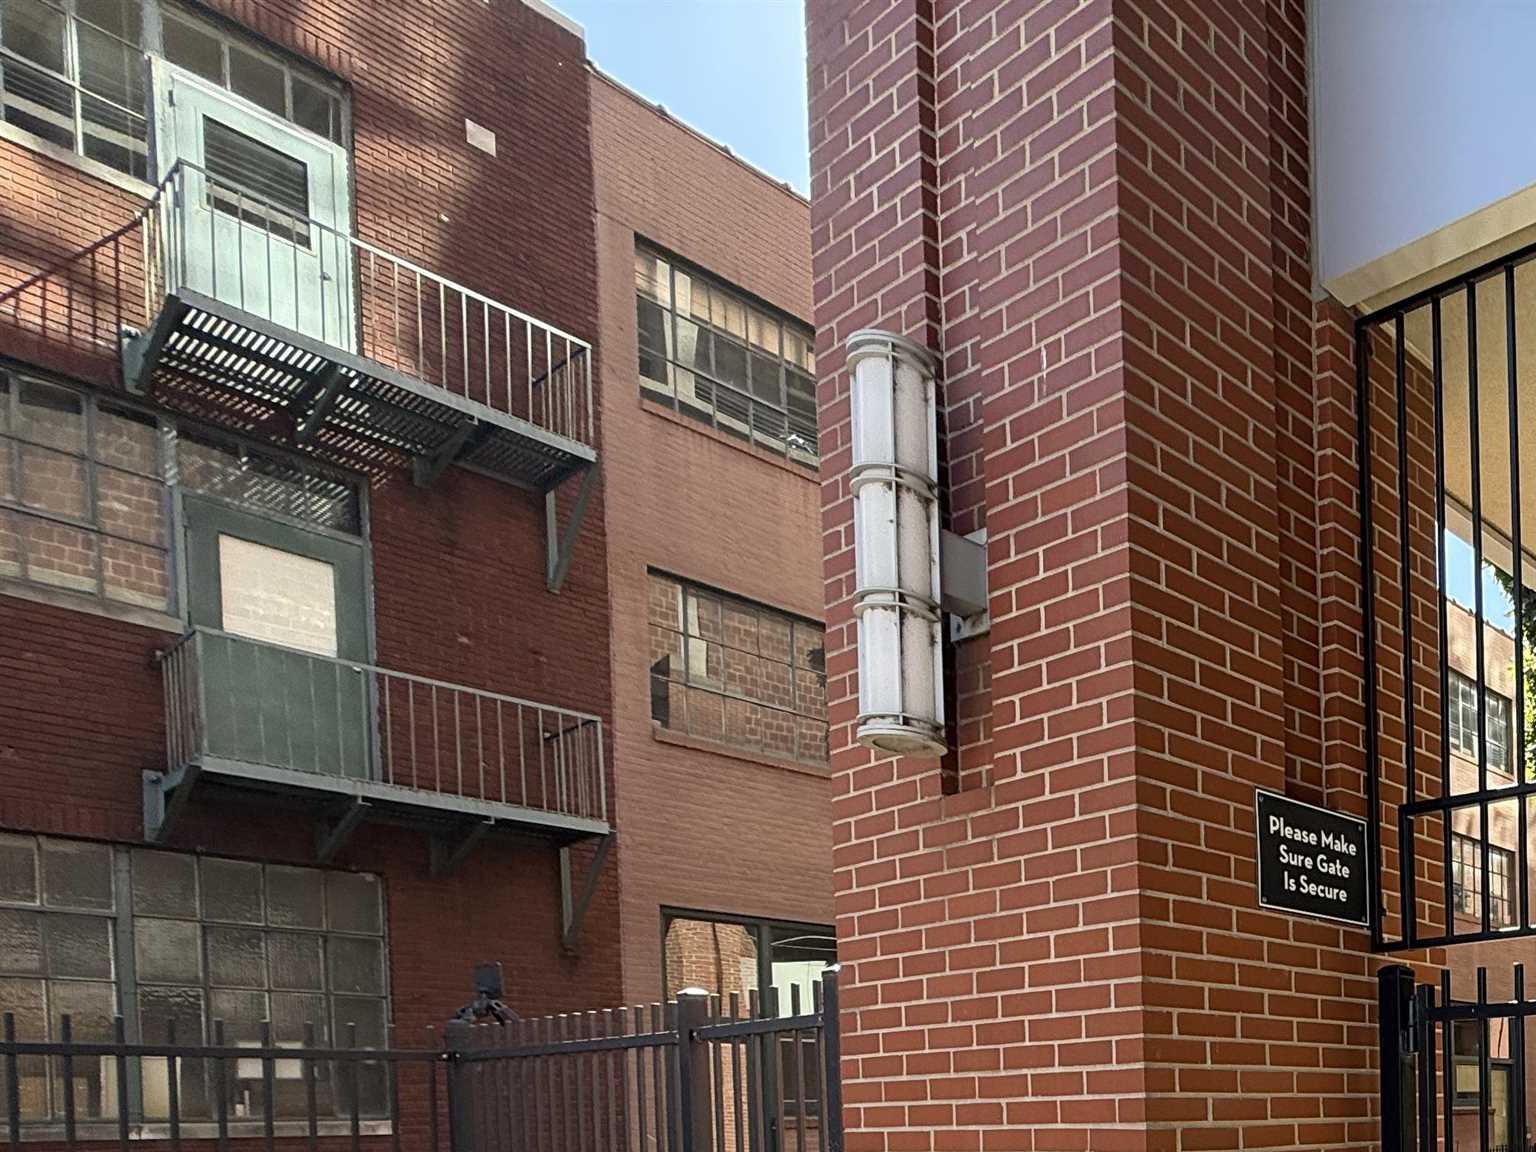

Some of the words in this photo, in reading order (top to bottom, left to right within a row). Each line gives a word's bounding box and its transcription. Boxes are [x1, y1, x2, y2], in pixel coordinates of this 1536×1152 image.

[1269, 815, 1318, 845] Please
[1321, 830, 1357, 856] Make
[1280, 844, 1313, 869] Sure
[1317, 854, 1350, 878] Gate
[1284, 871, 1296, 891] Is
[1300, 875, 1347, 902] Secure
